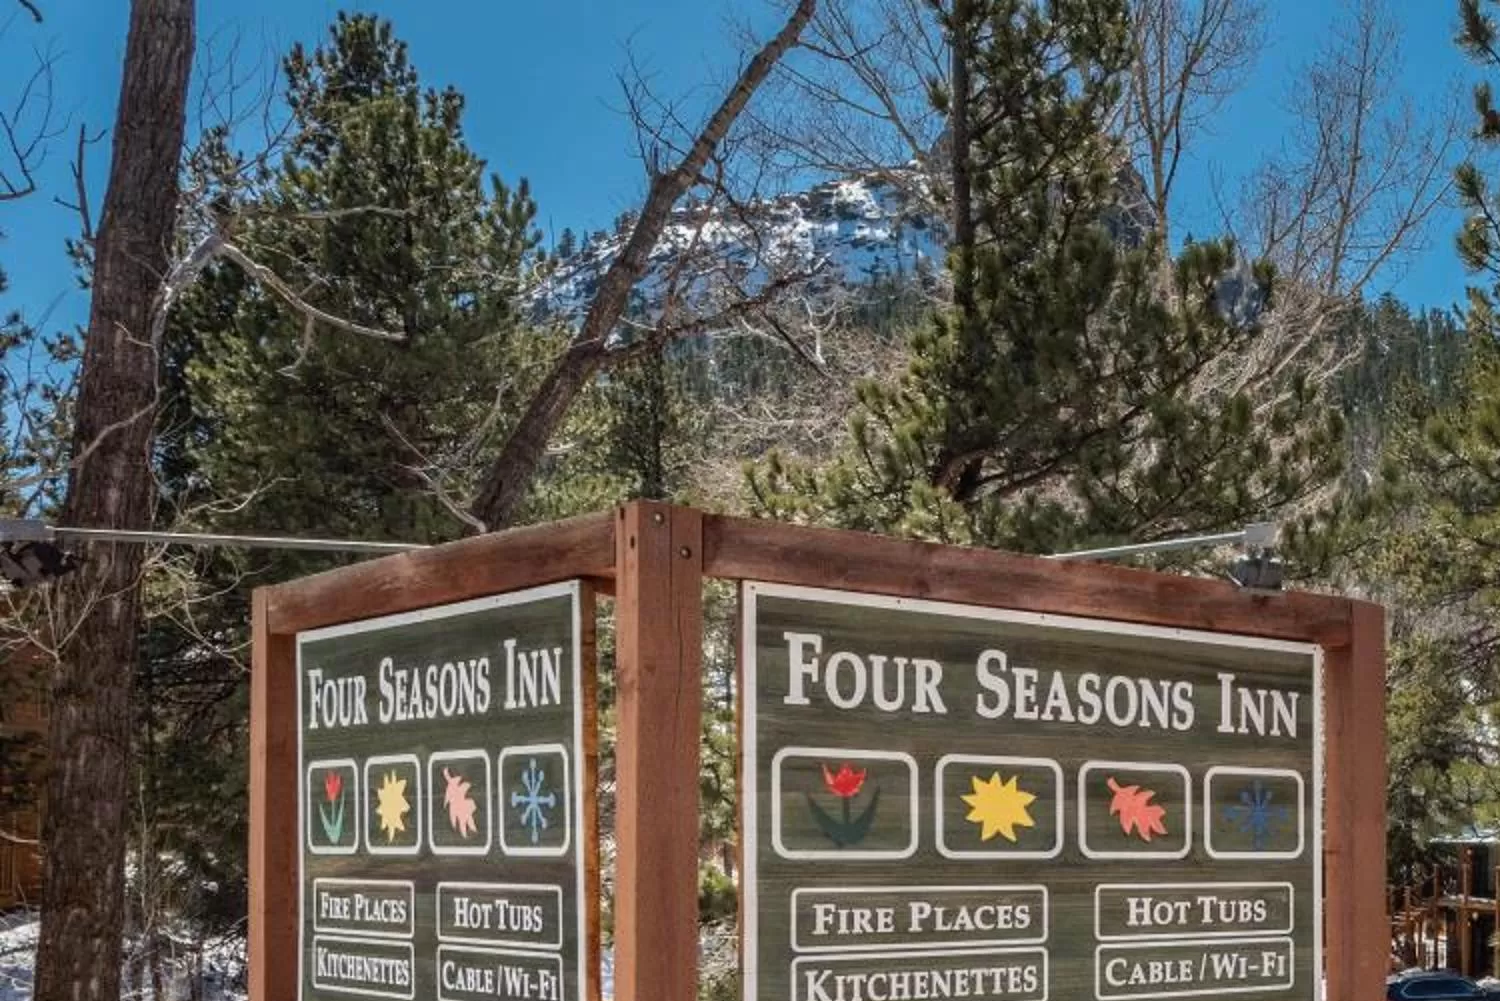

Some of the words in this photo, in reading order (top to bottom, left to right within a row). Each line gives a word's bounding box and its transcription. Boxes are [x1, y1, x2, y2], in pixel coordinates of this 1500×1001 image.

[308, 667, 369, 730] FOUR
[379, 656, 491, 724] SEASONS
[504, 638, 563, 709] INN
[783, 631, 947, 716] FOUR
[976, 648, 1195, 732] SEASONS
[1217, 672, 1300, 738] INN
[319, 892, 350, 920] FIRE
[354, 893, 407, 923] PLACES
[454, 897, 493, 929] HOT
[495, 899, 543, 933] TUBS
[812, 903, 895, 936] FIRE
[908, 901, 1031, 933] PLACES
[1126, 897, 1191, 926] HOT
[1197, 896, 1267, 924] TUBS
[317, 947, 409, 986] KITCHENETTES
